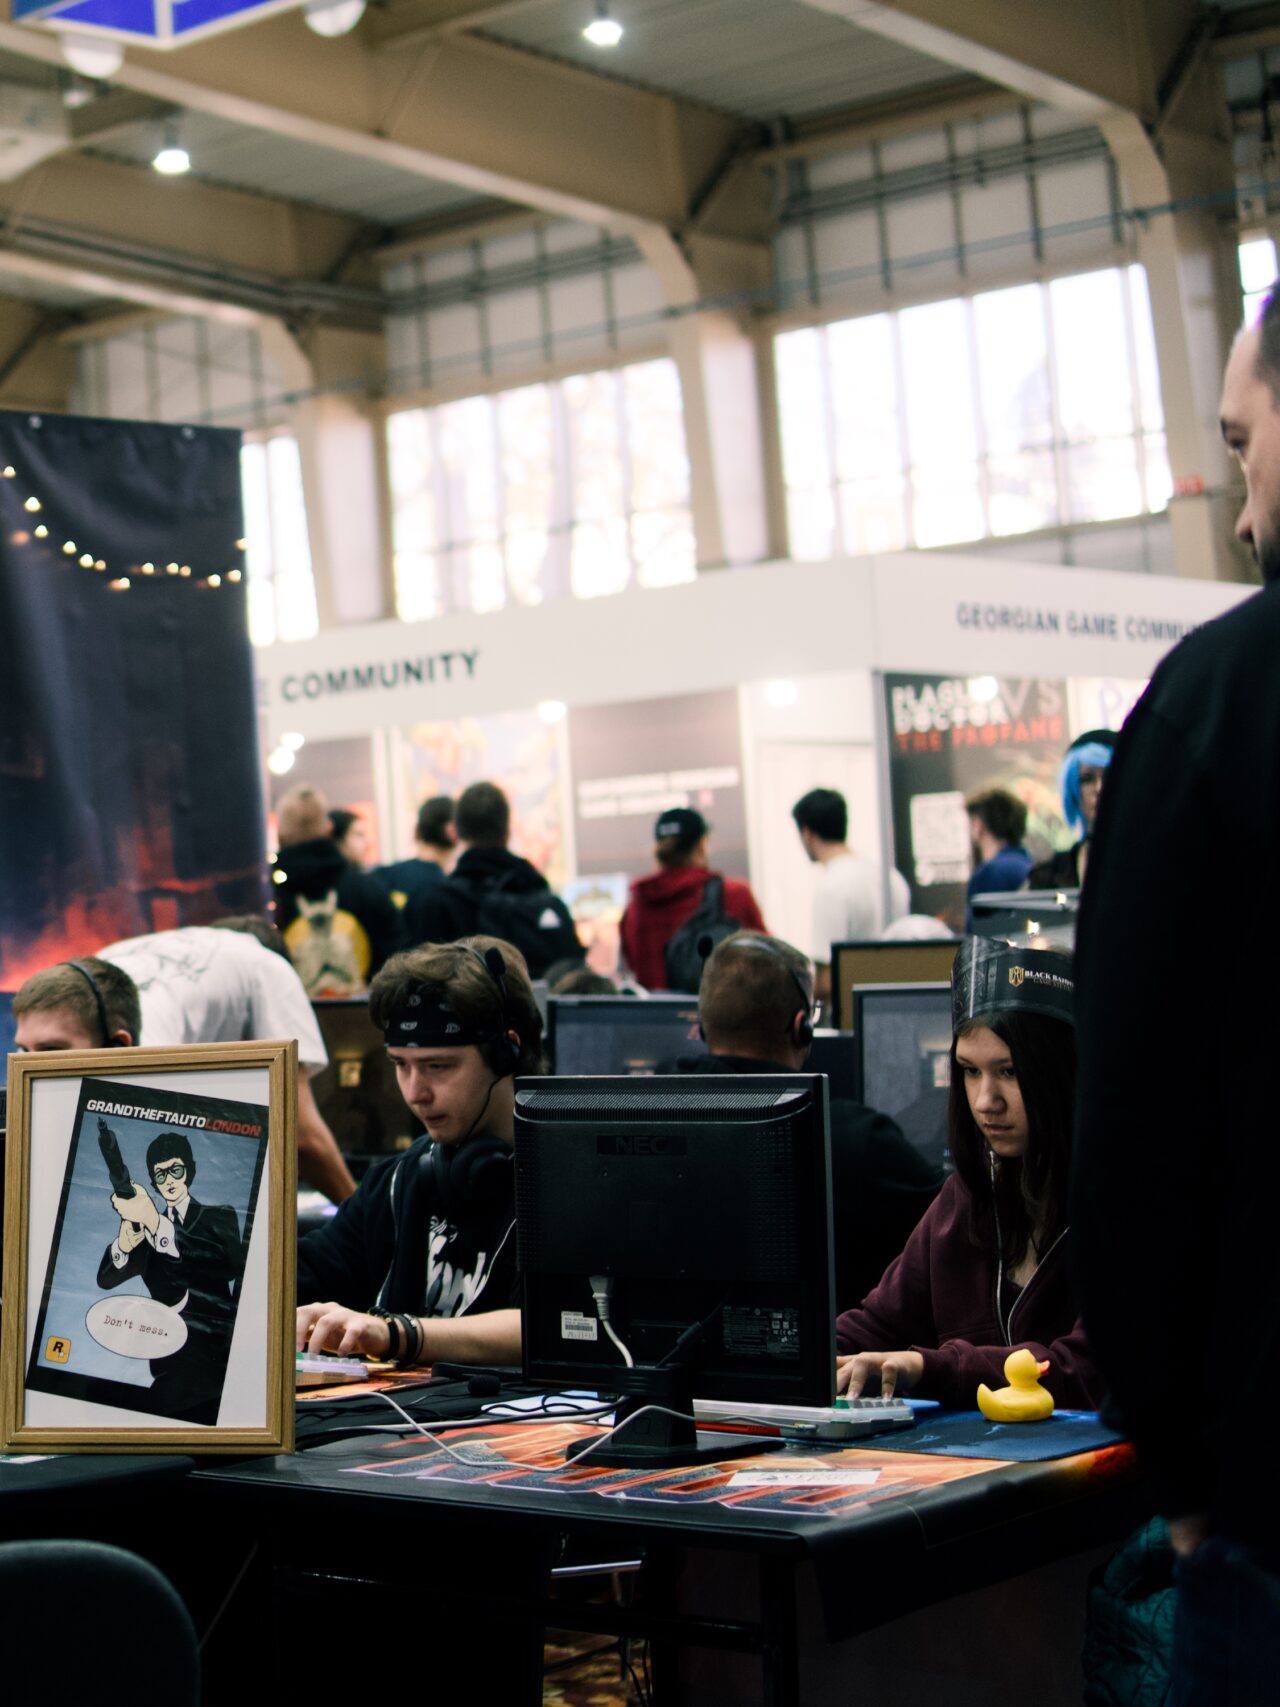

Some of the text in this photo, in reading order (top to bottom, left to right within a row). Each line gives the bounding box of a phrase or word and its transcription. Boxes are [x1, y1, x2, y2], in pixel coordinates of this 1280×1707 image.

[956, 601, 1060, 632] GEORGIAN
[1066, 609, 1119, 638] GAME
[281, 648, 479, 702] COMMUNITY
[204, 1118, 262, 1137] LONDON
[616, 1136, 668, 1153] NEC
[104, 1315, 169, 1337] Don't mess.
